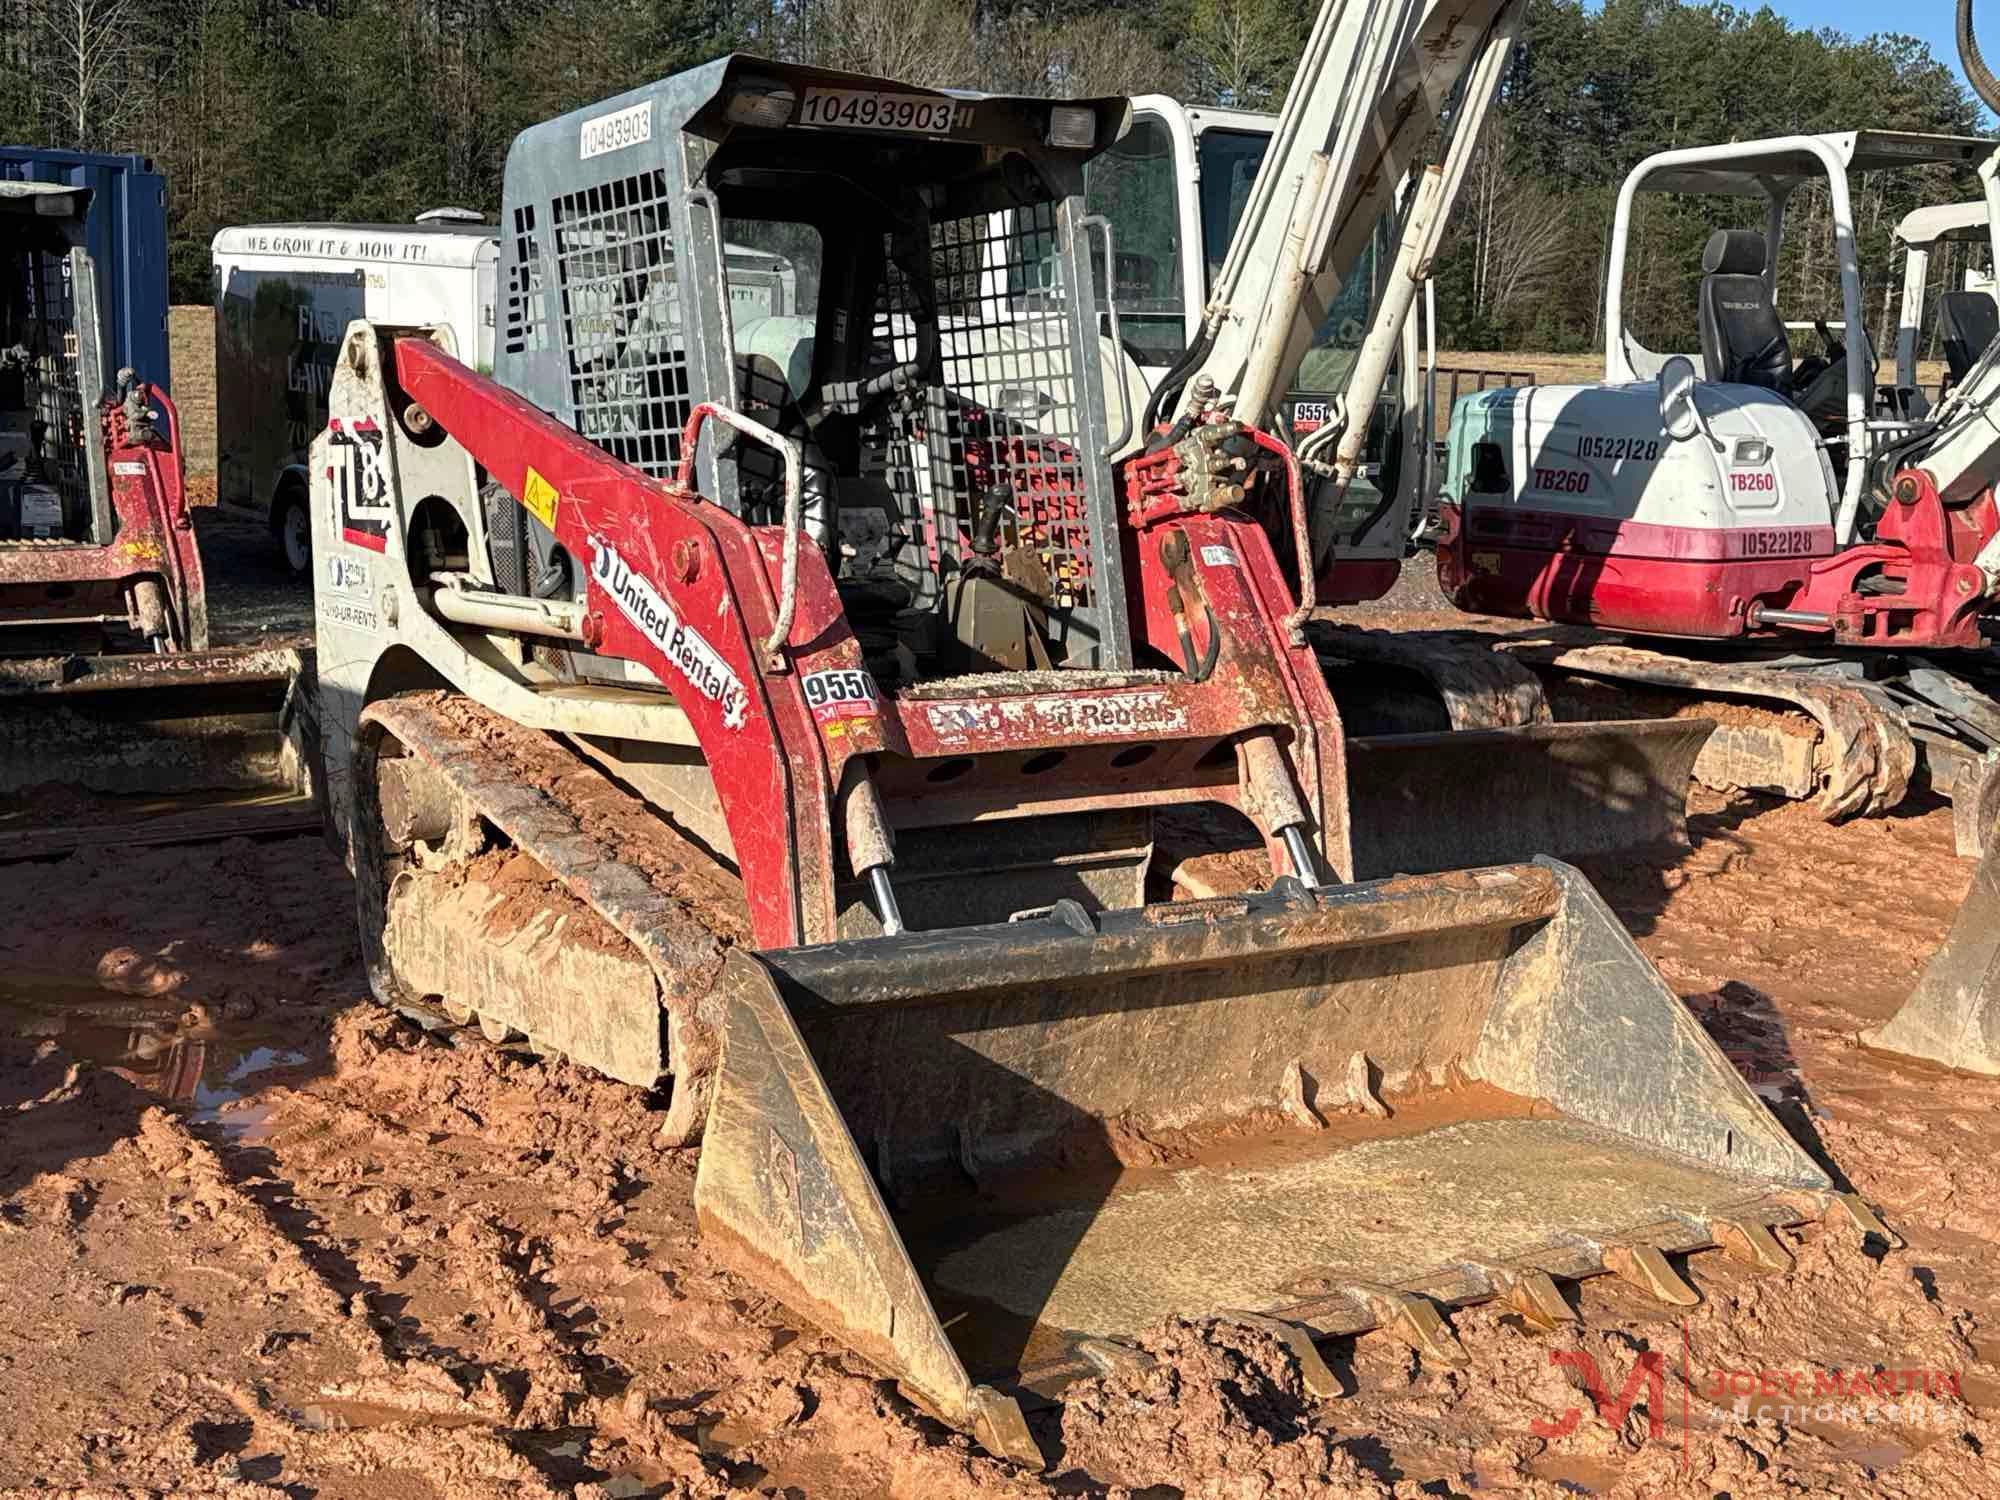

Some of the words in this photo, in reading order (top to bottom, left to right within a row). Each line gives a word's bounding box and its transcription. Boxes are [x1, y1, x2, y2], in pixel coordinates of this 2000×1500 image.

[806, 96, 950, 130] 10493903
[583, 110, 649, 154] 10493903
[248, 237, 267, 250] WE
[273, 238, 312, 254] GROW
[319, 240, 335, 254] IT
[359, 242, 394, 257] MOW
[1577, 436, 1659, 461] 10522128
[1534, 468, 1590, 493] TB260
[1729, 473, 1774, 491] TB260
[1741, 531, 1812, 556] 10522128
[612, 562, 671, 643] United
[669, 626, 740, 714] Rentals
